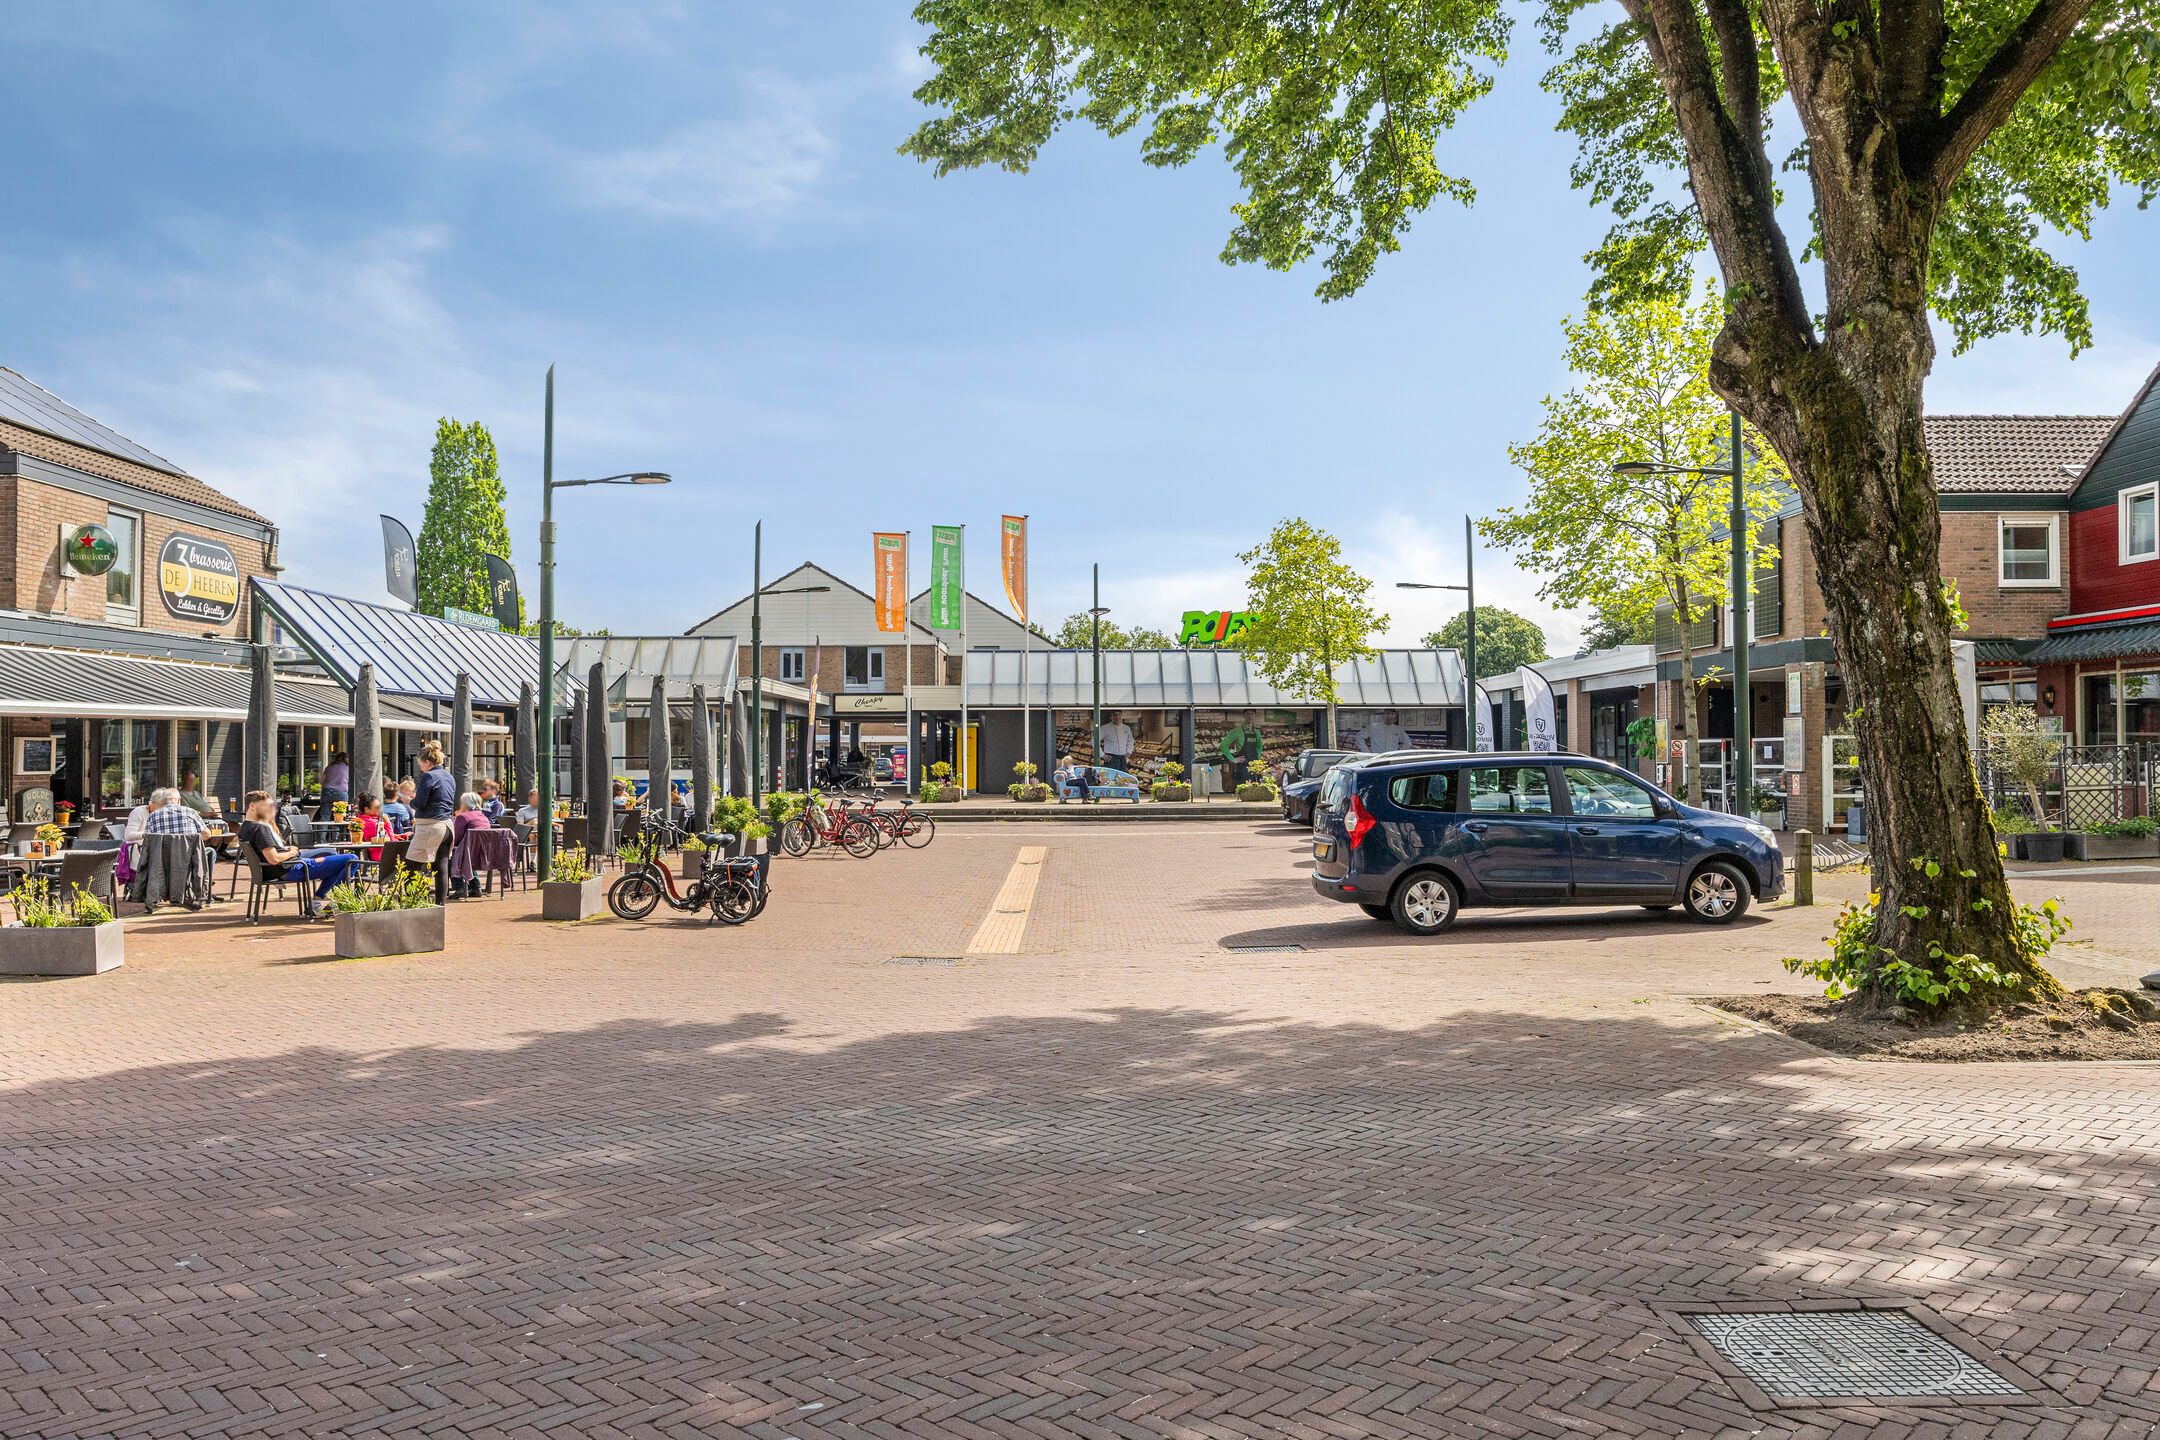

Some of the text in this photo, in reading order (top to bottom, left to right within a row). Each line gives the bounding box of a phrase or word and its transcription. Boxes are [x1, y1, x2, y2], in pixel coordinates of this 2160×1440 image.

[69, 552, 110, 561] Heineken
[189, 546, 233, 572] brasserie
[165, 543, 235, 598] DE 3 HEEREN
[177, 598, 197, 613] Lekker
[197, 602, 203, 612] &
[1180, 611, 1261, 643] POIES
[854, 697, 884, 708] Cheapy
